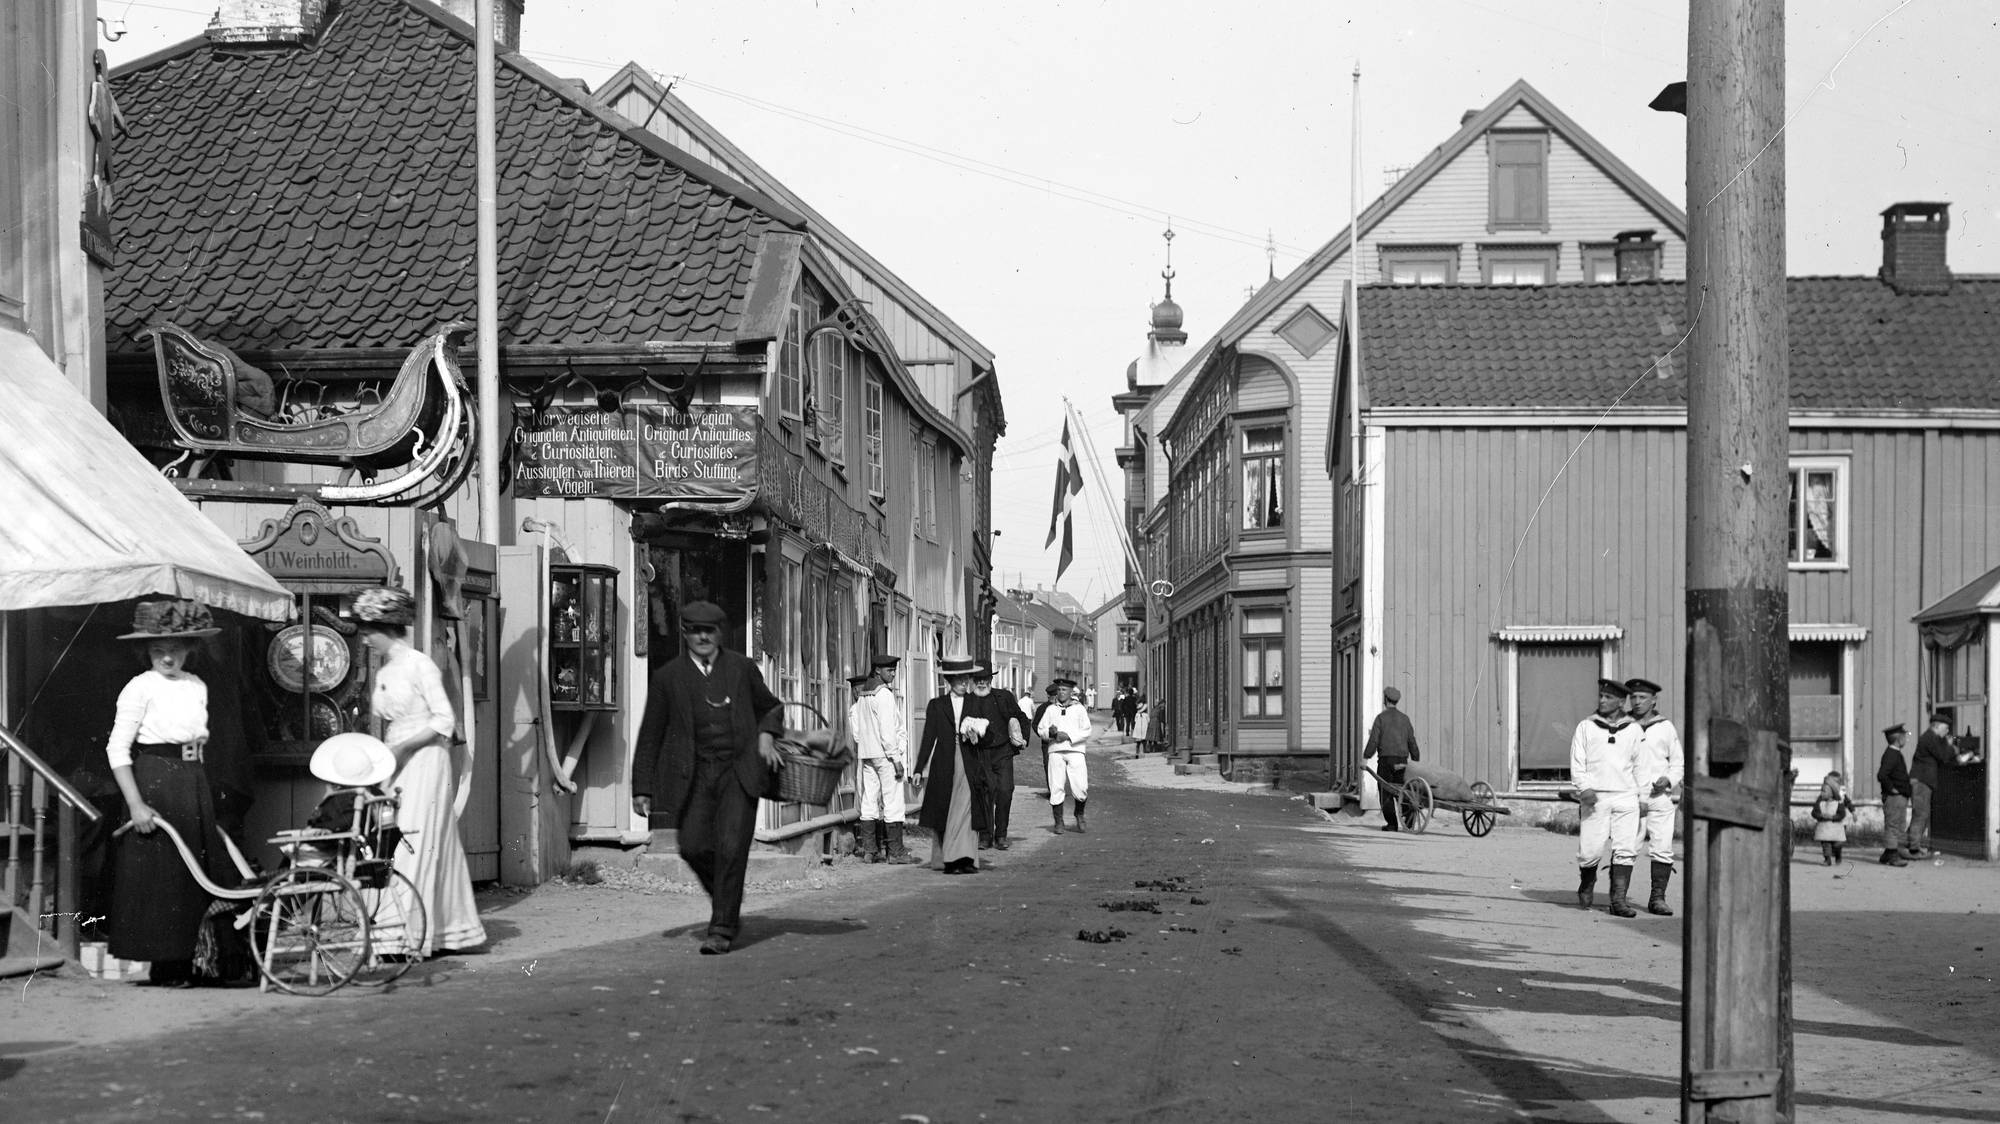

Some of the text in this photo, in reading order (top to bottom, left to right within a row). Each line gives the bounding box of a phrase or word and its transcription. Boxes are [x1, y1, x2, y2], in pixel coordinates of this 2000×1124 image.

[532, 410, 610, 429] Norwegische
[662, 406, 733, 430] Norwegian
[514, 426, 568, 447] Originalen
[644, 424, 689, 445] Original
[541, 442, 617, 460] Curiositäten.
[671, 441, 738, 460] Curiosities.
[516, 459, 635, 482] Ausstopfen von Thieren
[655, 459, 741, 483] Birds Stuffing.
[556, 479, 598, 497] Vögeln.
